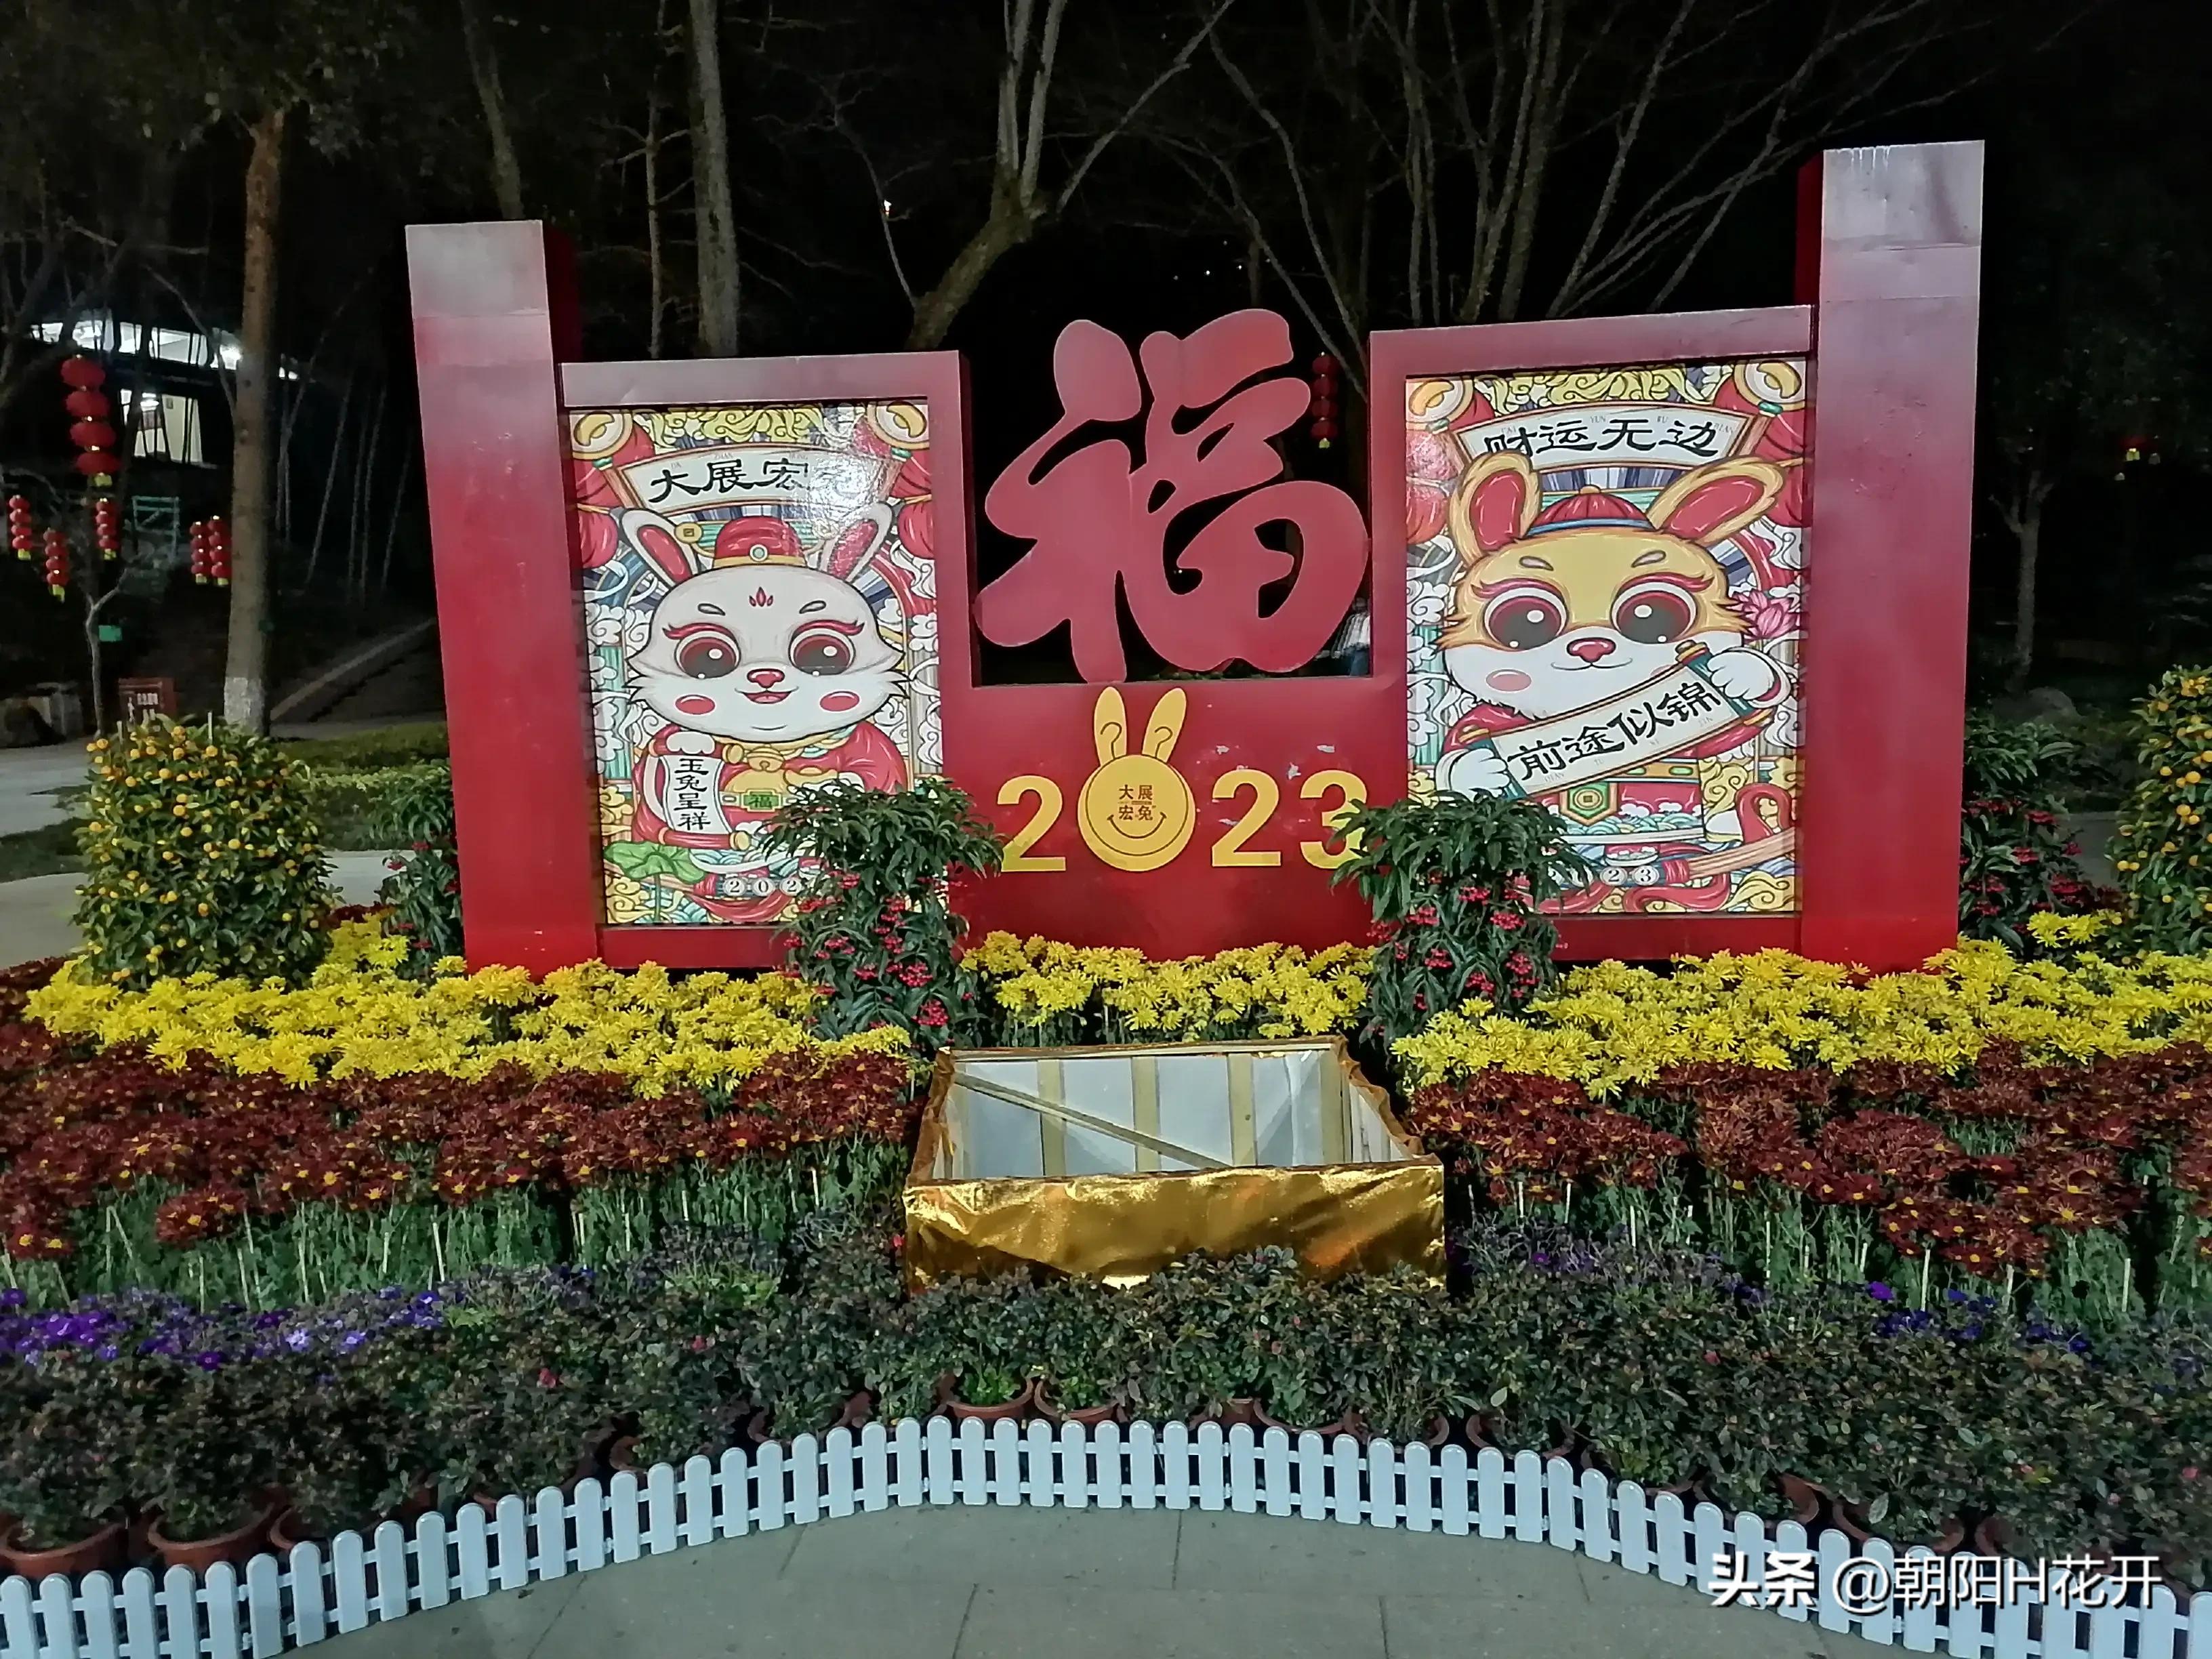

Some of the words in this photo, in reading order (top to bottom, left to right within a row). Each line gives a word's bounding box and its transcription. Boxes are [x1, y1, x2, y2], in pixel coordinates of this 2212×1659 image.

[1483, 418, 1718, 457] 财运无边
[649, 457, 840, 504] 大展宏
[972, 308, 1370, 682] 福
[1507, 681, 1721, 781] 前途似锦
[673, 758, 712, 831] 玉兔呈祥
[1118, 784, 1153, 800] 大展
